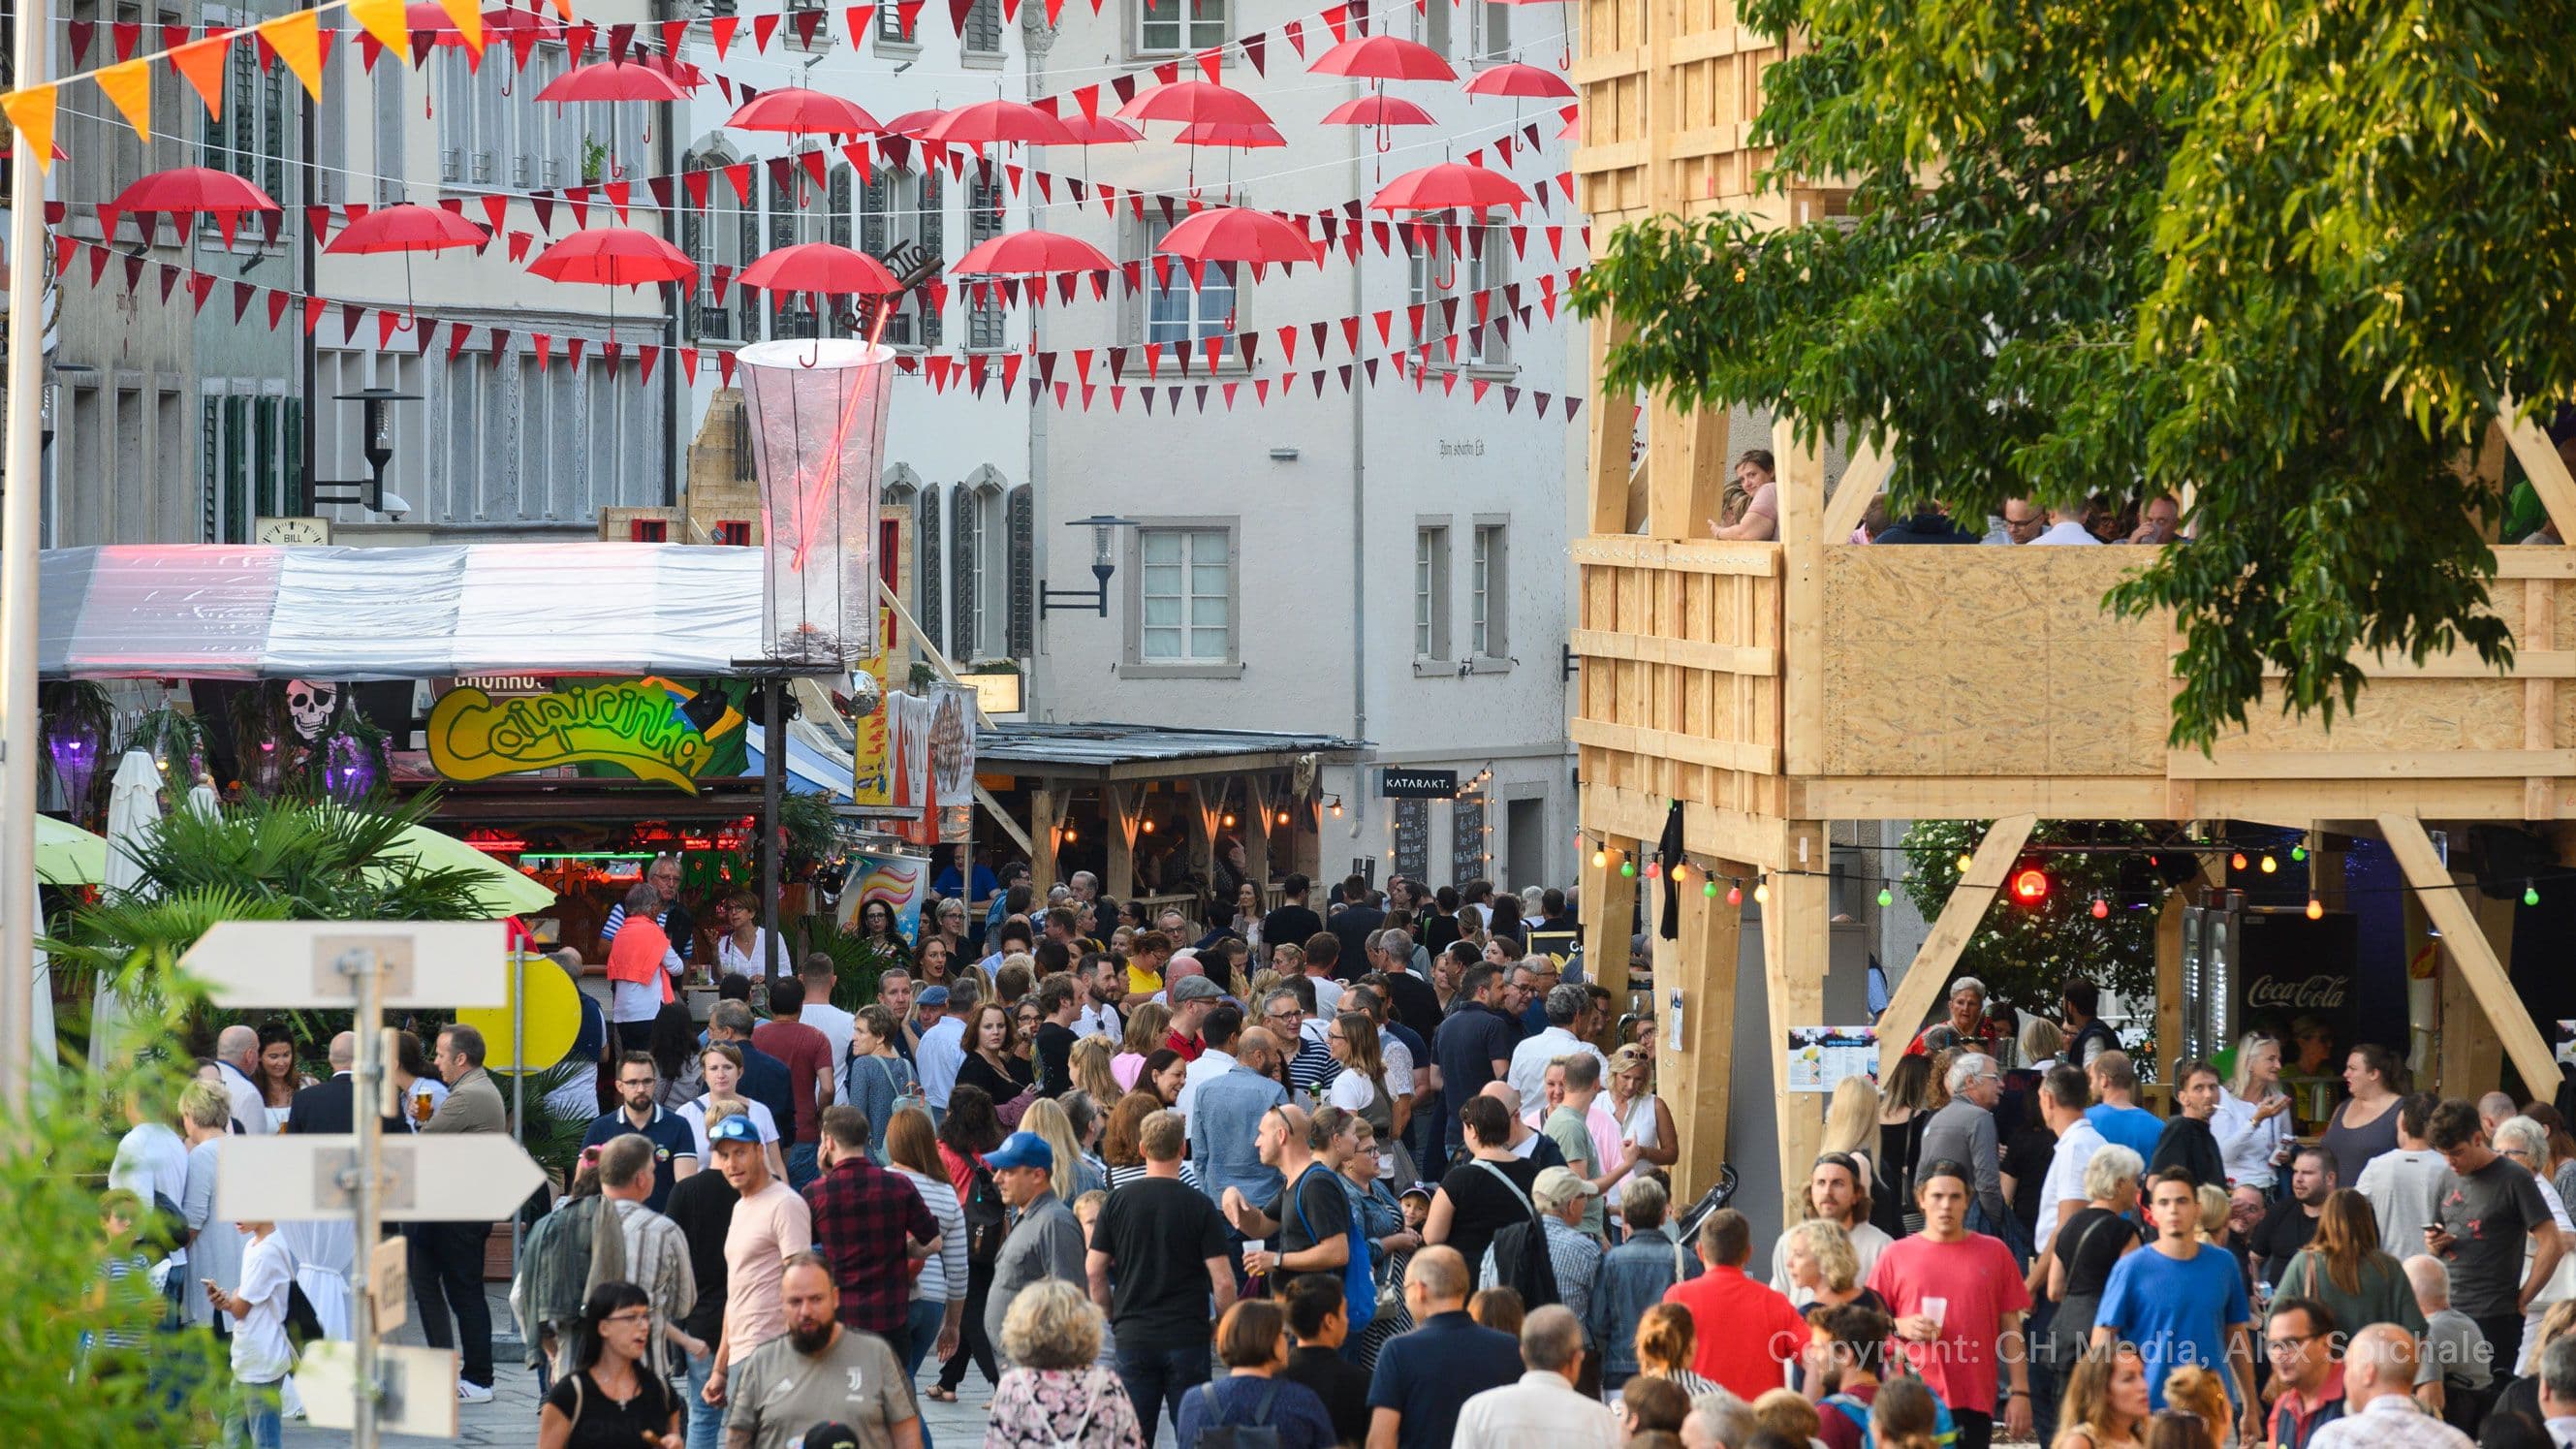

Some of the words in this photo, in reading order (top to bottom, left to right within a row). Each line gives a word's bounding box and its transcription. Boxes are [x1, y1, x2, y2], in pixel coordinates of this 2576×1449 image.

[283, 533, 302, 544] BILL
[427, 679, 711, 787] Caipirinha
[1386, 777, 1450, 790] KATARAKT.
[2248, 974, 2349, 1008] Coca-Cola
